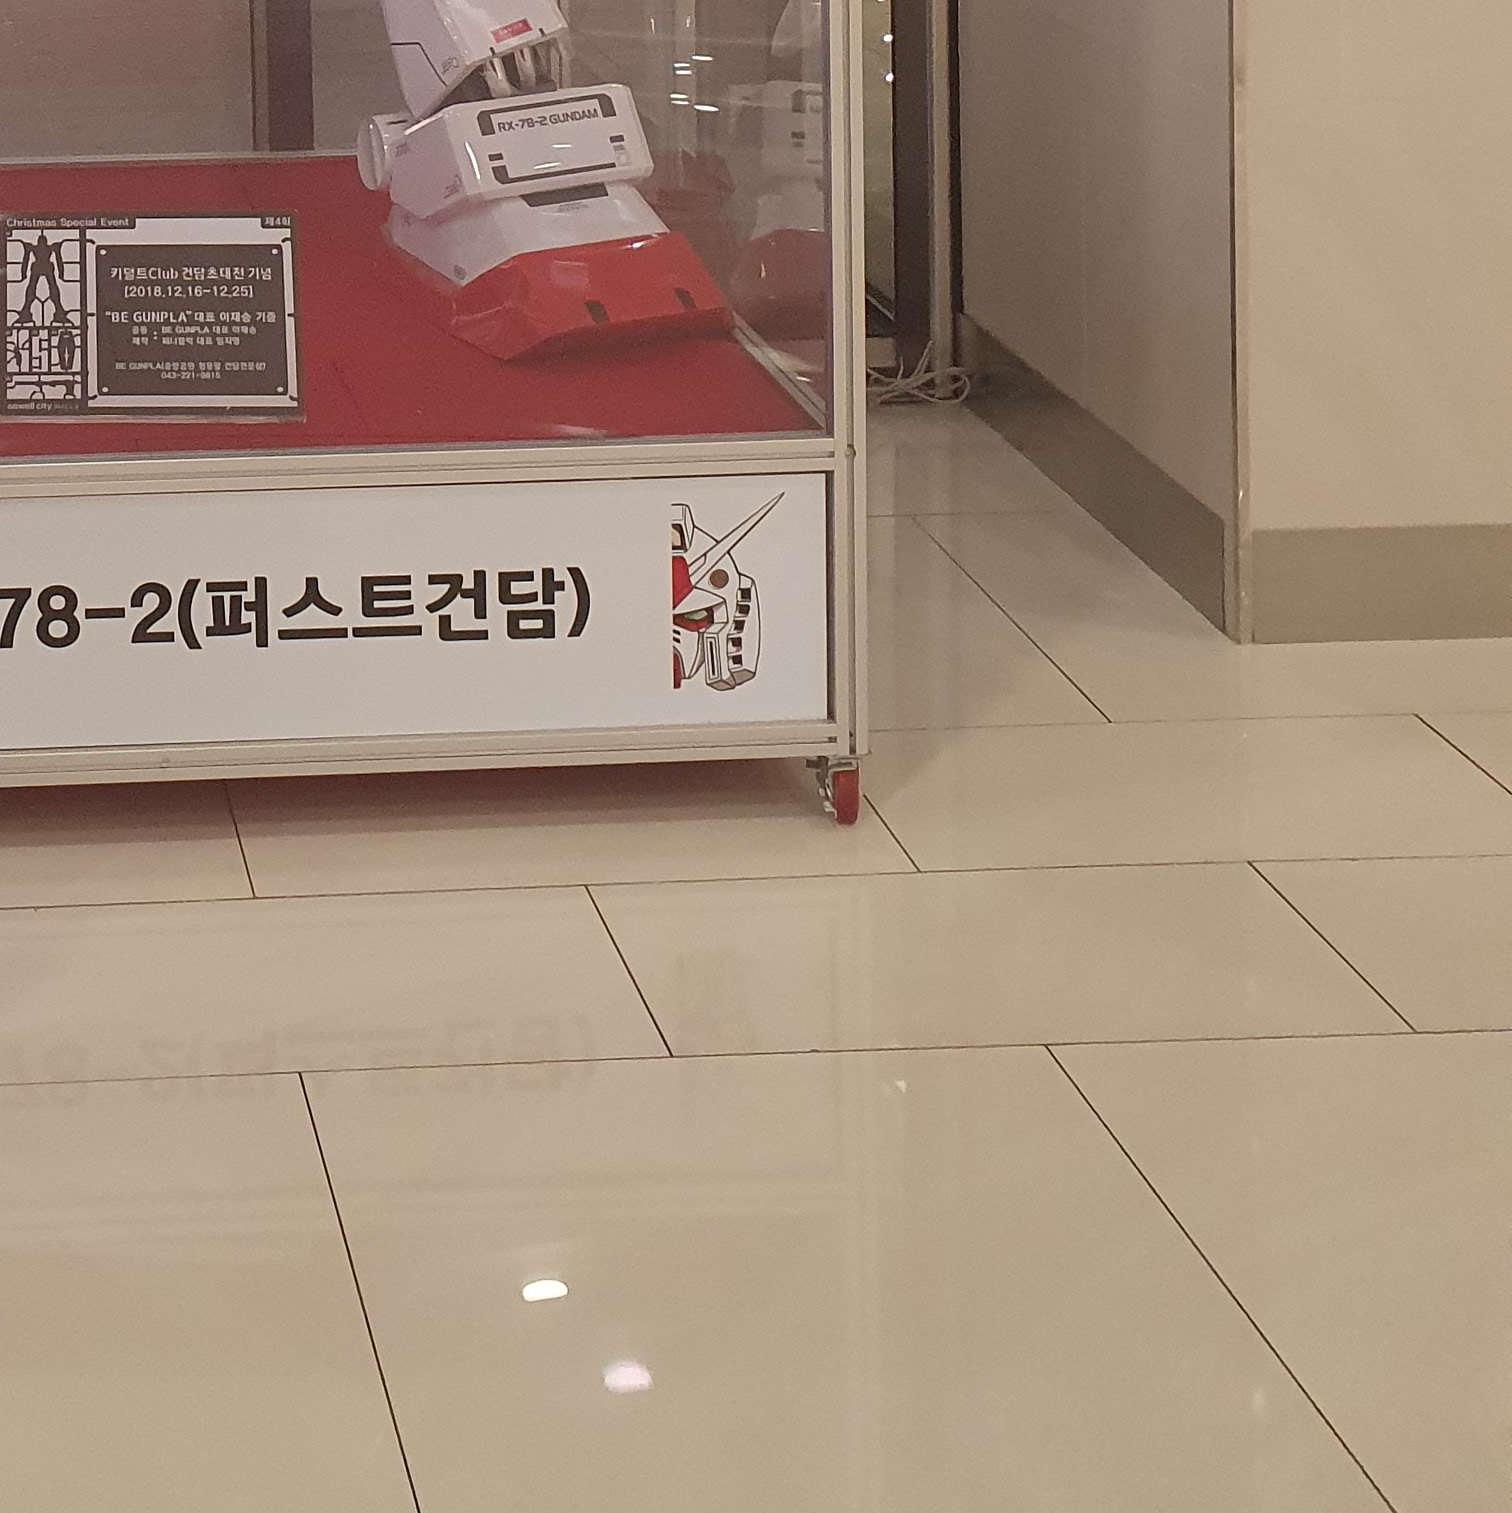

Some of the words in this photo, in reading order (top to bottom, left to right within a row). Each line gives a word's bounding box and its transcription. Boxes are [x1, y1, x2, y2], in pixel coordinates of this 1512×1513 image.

[497, 115, 548, 133] RX-78-2
[548, 108, 599, 125] GUNDAM
[6, 217, 57, 228] Christmas
[60, 217, 97, 228] Special
[100, 217, 130, 227] Event
[110, 267, 179, 281] 키덜트Club
[182, 267, 245, 280] 건담초대전
[248, 267, 272, 280] 기념
[194, 311, 216, 323] 대표
